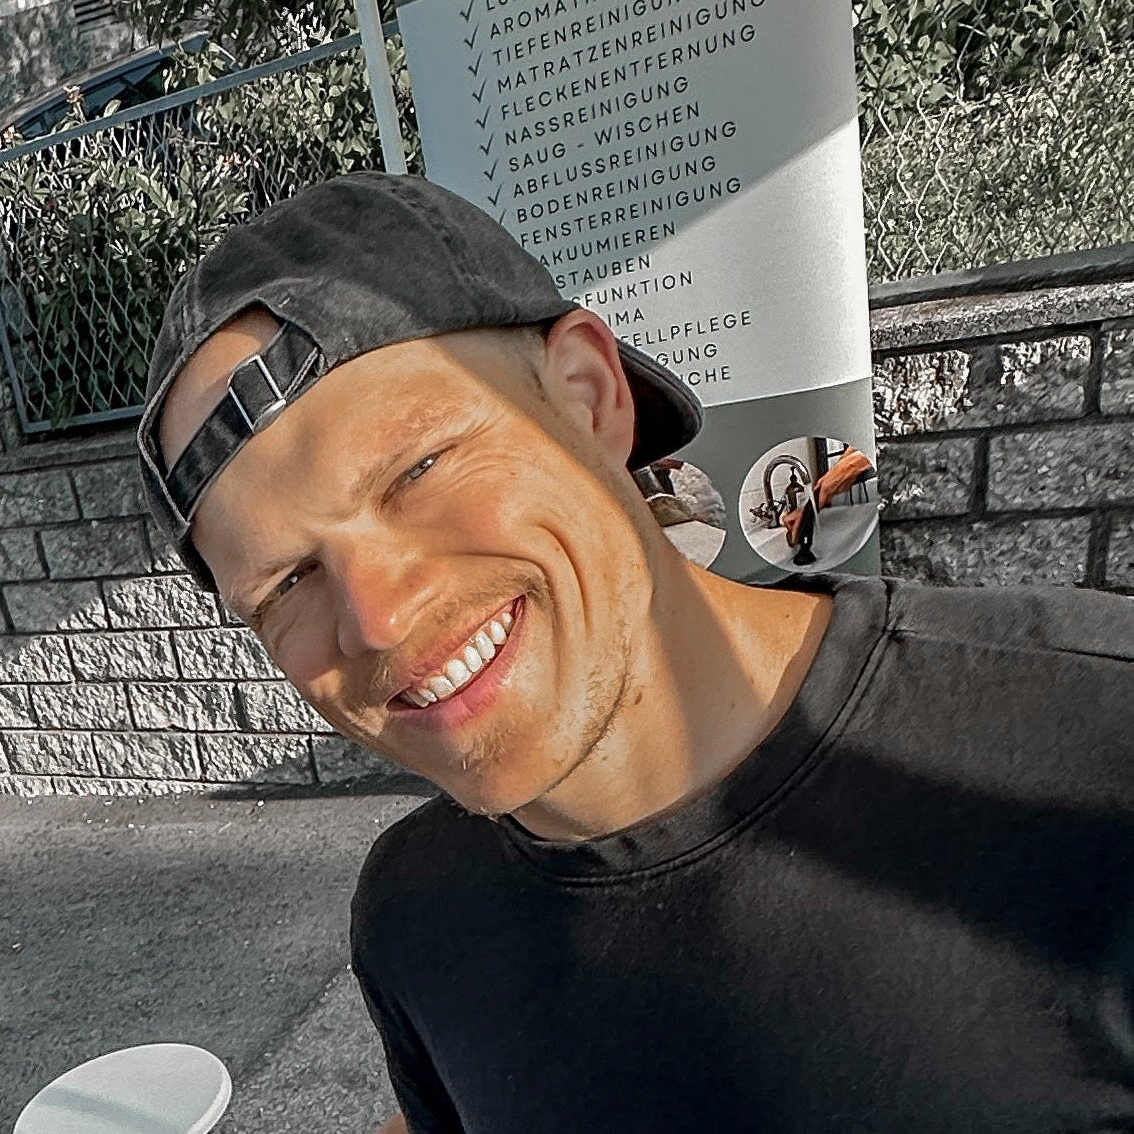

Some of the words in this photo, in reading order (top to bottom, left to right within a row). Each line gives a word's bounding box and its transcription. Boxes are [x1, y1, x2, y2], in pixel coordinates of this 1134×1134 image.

[490, 0, 598, 40] AROMA
[501, 24, 756, 120] FLECKENENTFERNUNG
[505, 76, 689, 146] NASSREINIGUNG
[509, 143, 566, 173] SAUG
[594, 101, 700, 146] WISCHEN
[513, 121, 737, 198] ABFLUSSREINIGUNG
[517, 155, 716, 223] BODENREINIGUNG
[521, 177, 741, 248] FENSTERREINIGUNG
[555, 254, 651, 290] STAUBEN
